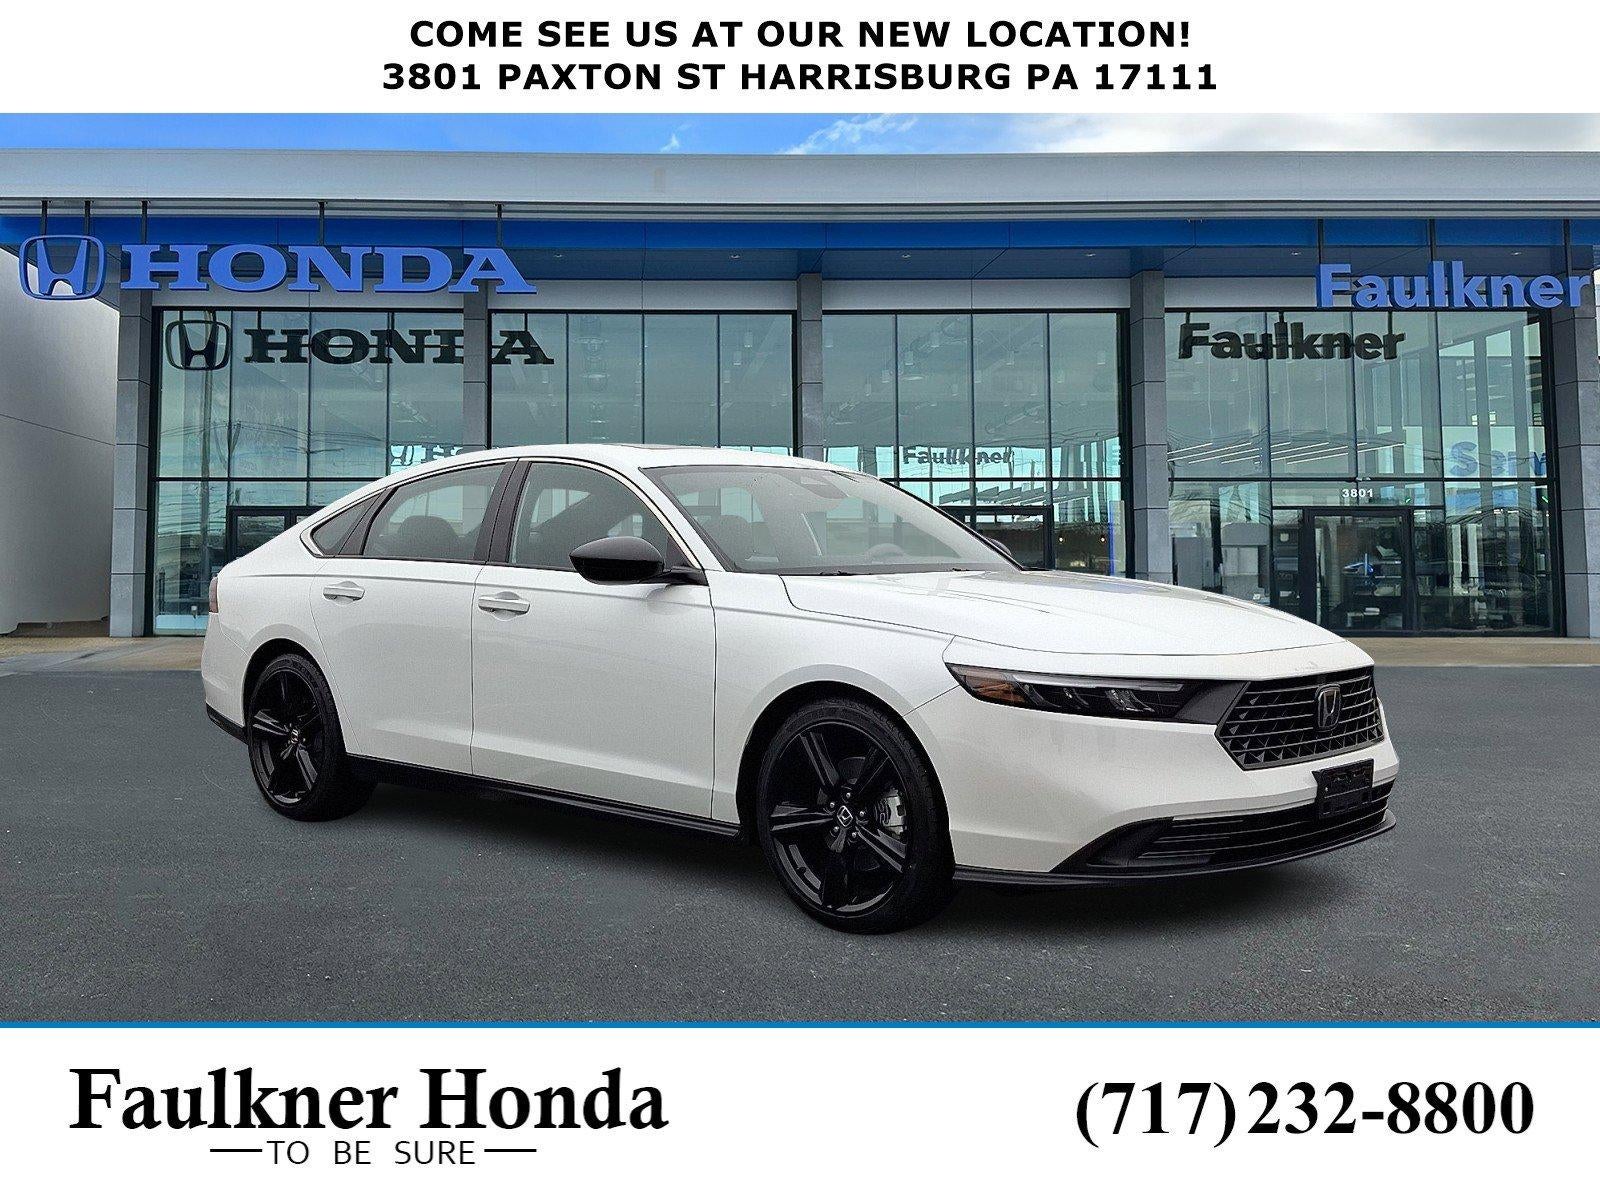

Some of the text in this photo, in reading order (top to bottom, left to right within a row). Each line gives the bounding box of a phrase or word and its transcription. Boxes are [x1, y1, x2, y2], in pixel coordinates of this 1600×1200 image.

[121, 243, 537, 294] HONDA
[1317, 261, 1591, 308] Faulkner
[1179, 322, 1404, 360] Faulkner
[1342, 488, 1373, 498] 3801
